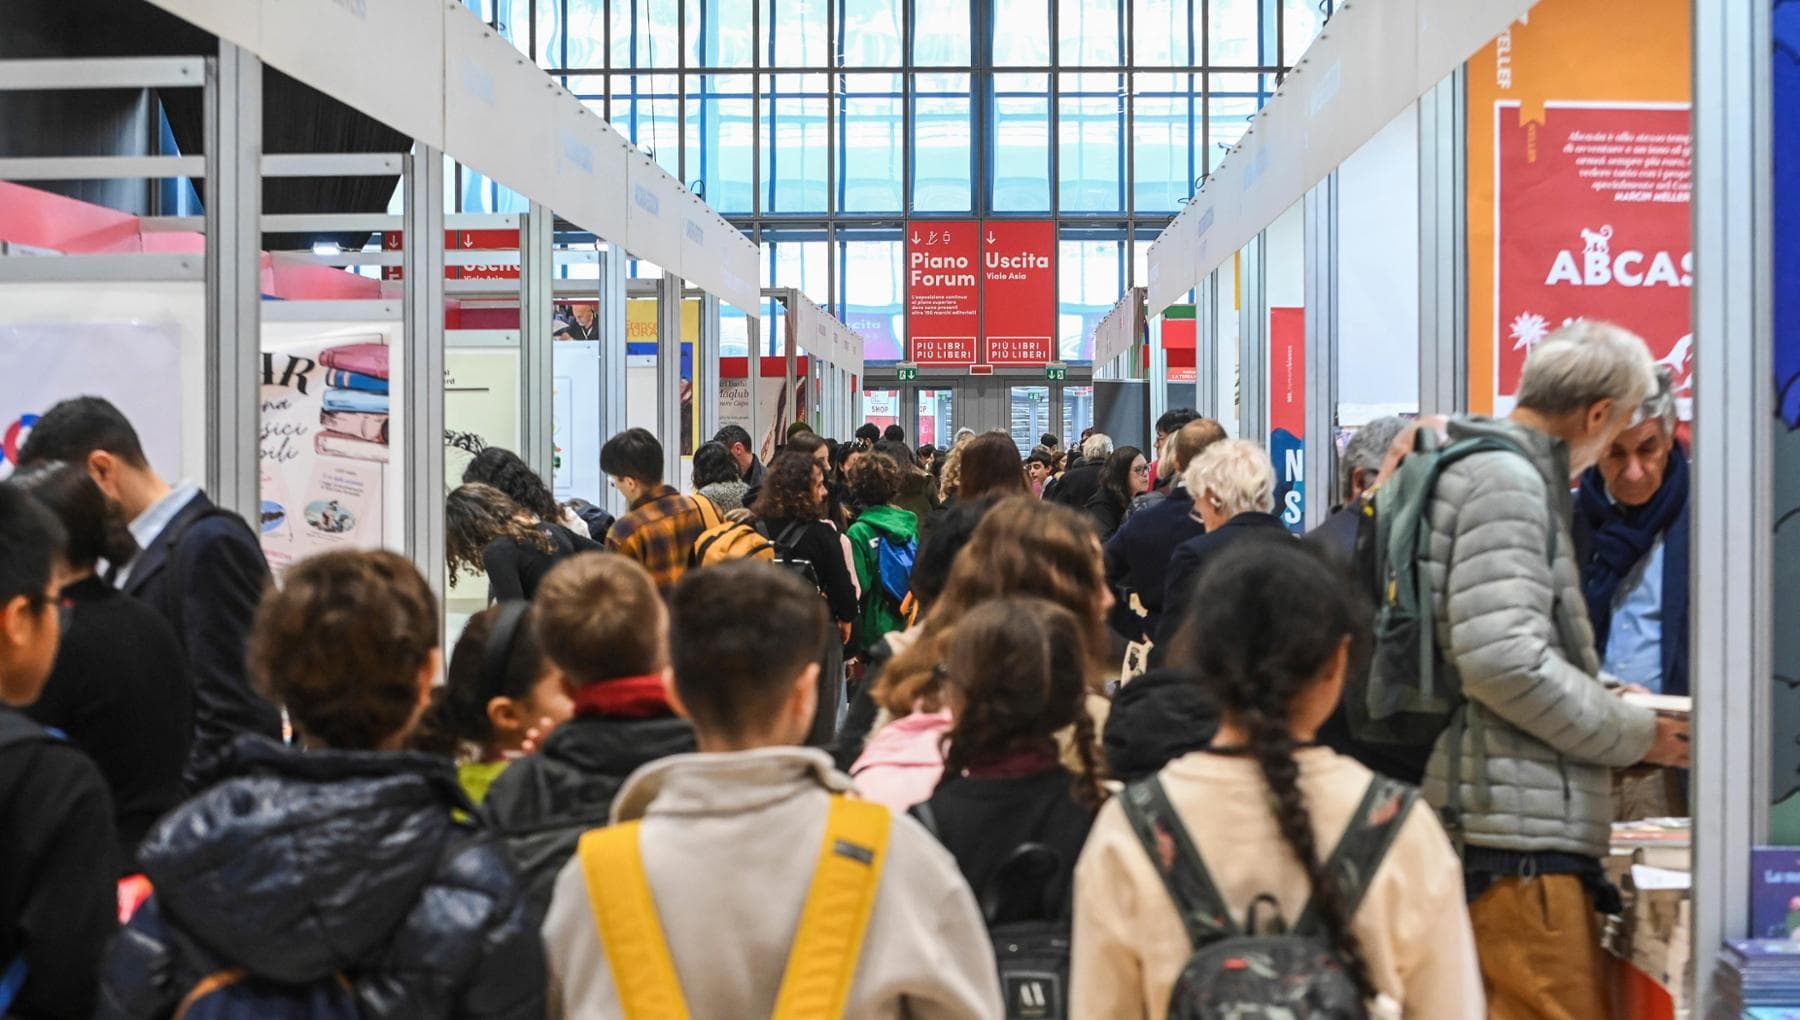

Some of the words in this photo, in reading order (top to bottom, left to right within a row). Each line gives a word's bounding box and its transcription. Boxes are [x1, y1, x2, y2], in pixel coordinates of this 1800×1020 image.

[911, 252, 969, 268] Piano
[985, 252, 1049, 268] Uscita
[911, 270, 976, 286] Forum
[986, 271, 1007, 280] Viale
[1008, 271, 1027, 280] Asia
[916, 341, 934, 350] PIÙ
[937, 342, 965, 350] LIBRI
[991, 341, 1009, 350] PIÙ
[1012, 342, 1040, 350] LIBRI
[916, 350, 934, 359] PIÙ
[937, 351, 971, 359] LIBERI
[991, 350, 1009, 359] PIÙ
[1012, 351, 1046, 359] LIBERI
[871, 405, 889, 414] SHOP
[1285, 449, 1304, 482] N
[1284, 490, 1302, 525] S
